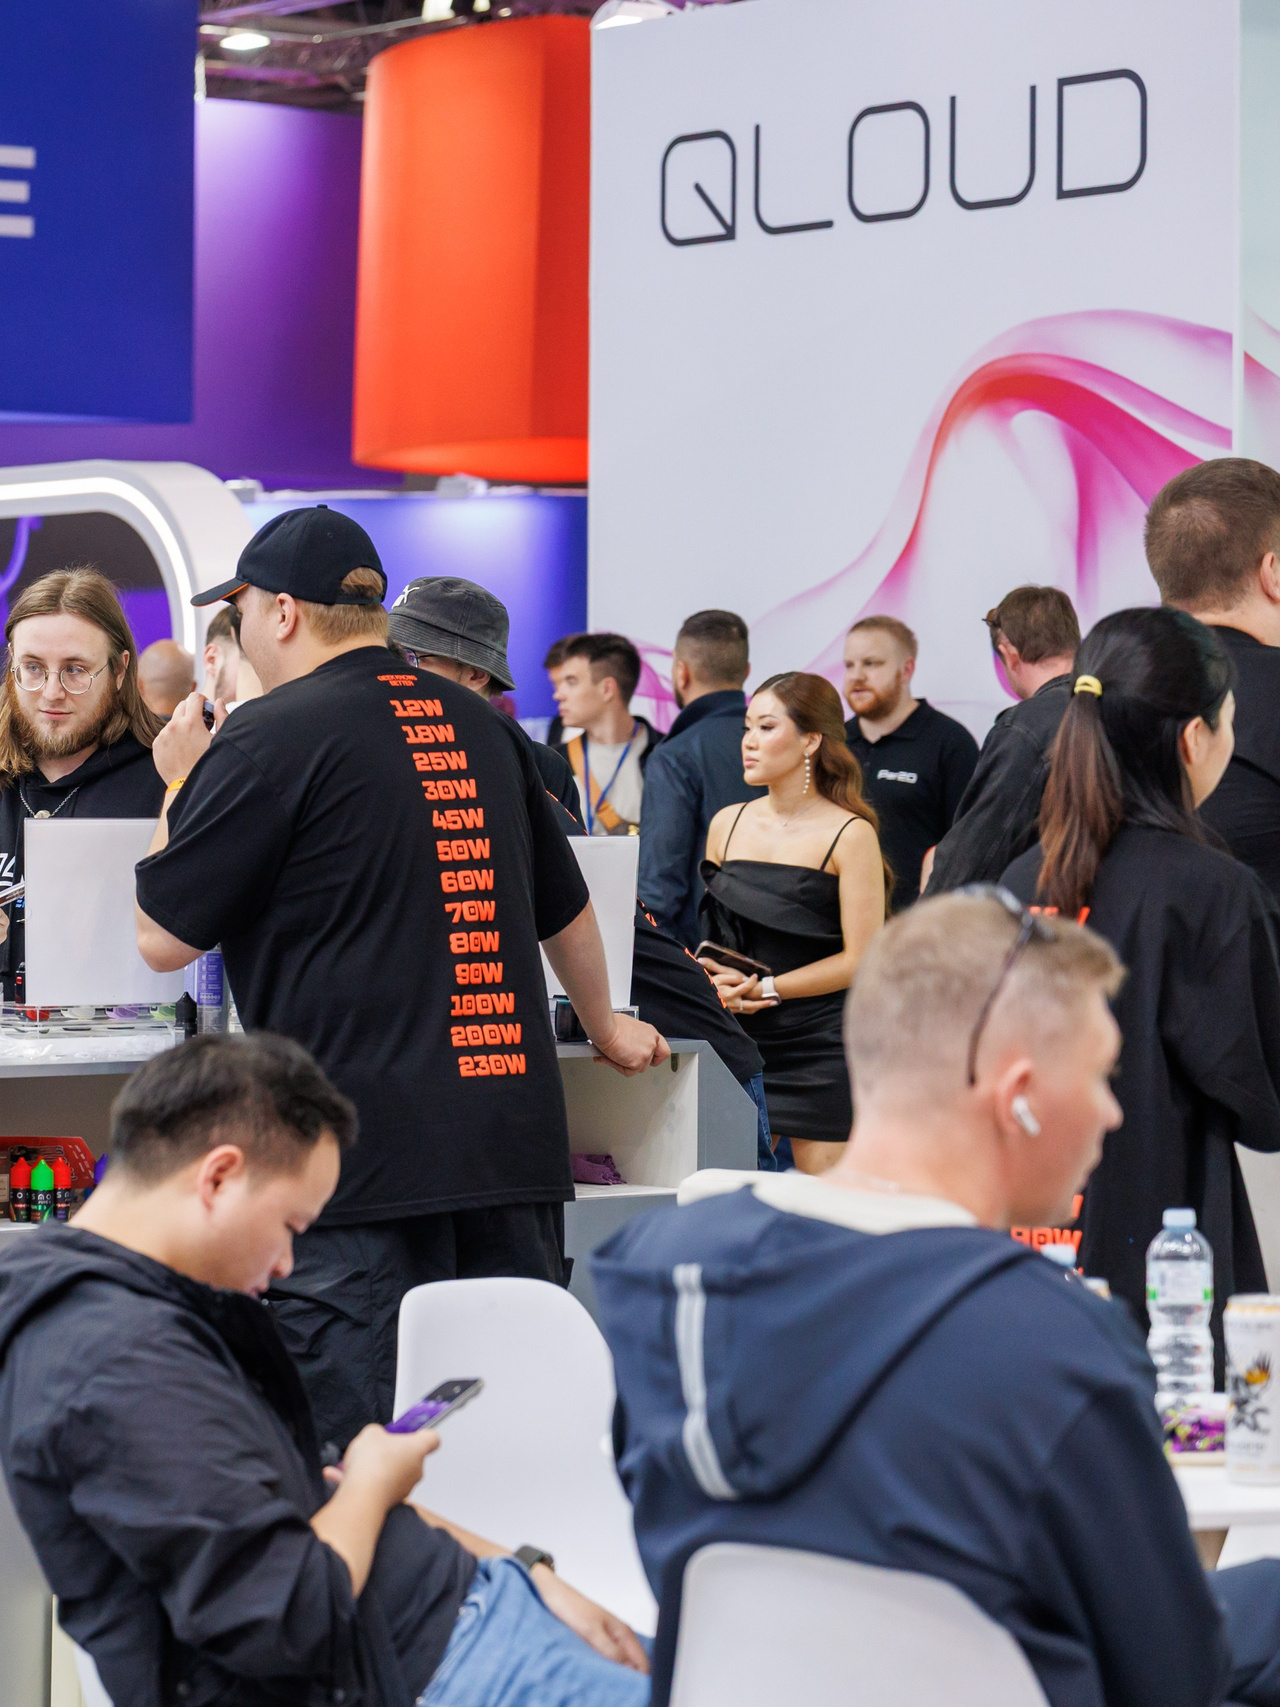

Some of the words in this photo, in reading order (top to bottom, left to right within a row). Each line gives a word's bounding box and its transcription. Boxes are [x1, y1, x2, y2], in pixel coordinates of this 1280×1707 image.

[661, 68, 1148, 248] QLOUD
[390, 699, 443, 717] 12W
[402, 724, 455, 744] 18W
[413, 751, 468, 772] 25W
[422, 779, 477, 800] 30W
[433, 808, 484, 830] 45W
[436, 838, 490, 861] 50W
[441, 869, 494, 893] 60W
[445, 901, 496, 923] 70W
[449, 931, 500, 954] 80W
[455, 962, 503, 985] 90W
[451, 993, 515, 1016] 100W
[450, 1023, 522, 1047] 200W
[458, 1054, 526, 1077] 230W
